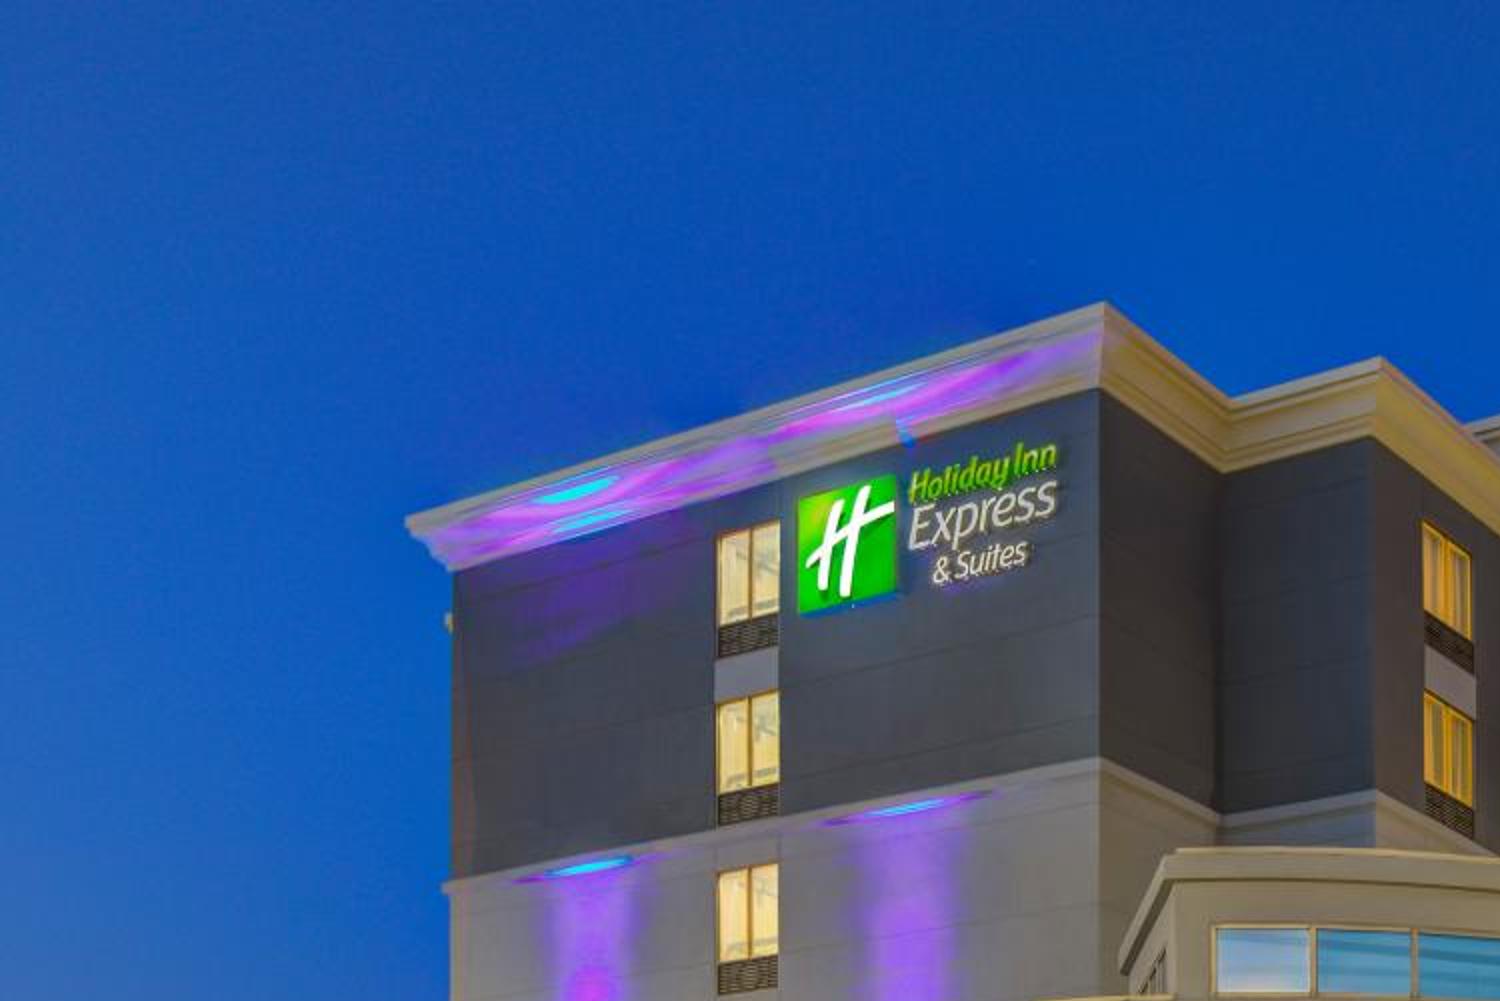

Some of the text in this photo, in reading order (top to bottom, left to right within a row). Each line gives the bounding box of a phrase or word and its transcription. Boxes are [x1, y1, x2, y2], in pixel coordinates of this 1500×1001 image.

[909, 442, 1057, 504] Holiday Inn
[909, 479, 1058, 550] Express
[932, 541, 1028, 584] & Suites
